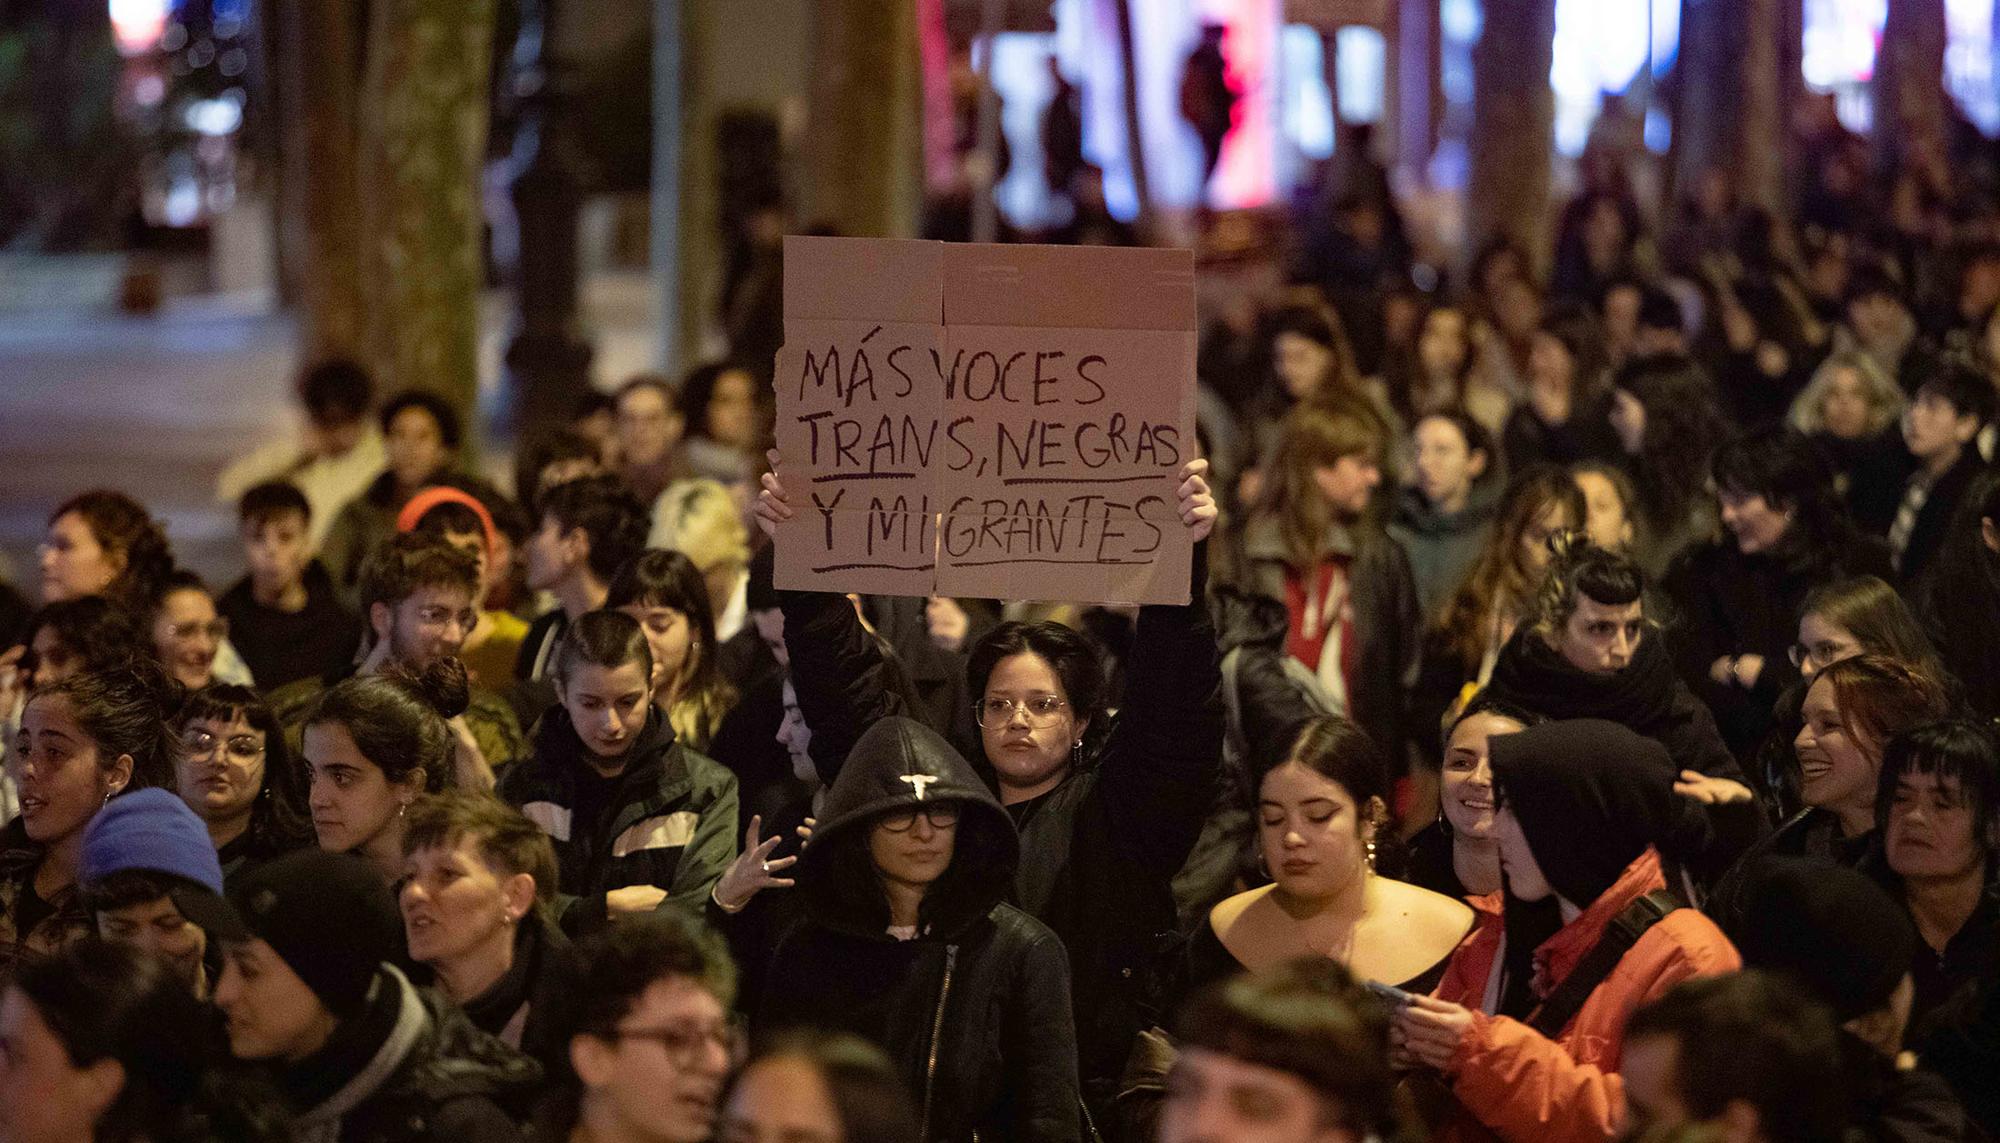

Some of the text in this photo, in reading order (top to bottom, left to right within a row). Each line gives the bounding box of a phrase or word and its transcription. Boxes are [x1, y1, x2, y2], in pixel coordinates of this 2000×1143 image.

[799, 325, 1107, 408] MÁS VOCES
[797, 411, 1180, 478] TRANS, NEGRAS
[811, 488, 1166, 563] Y MIGRANTES
